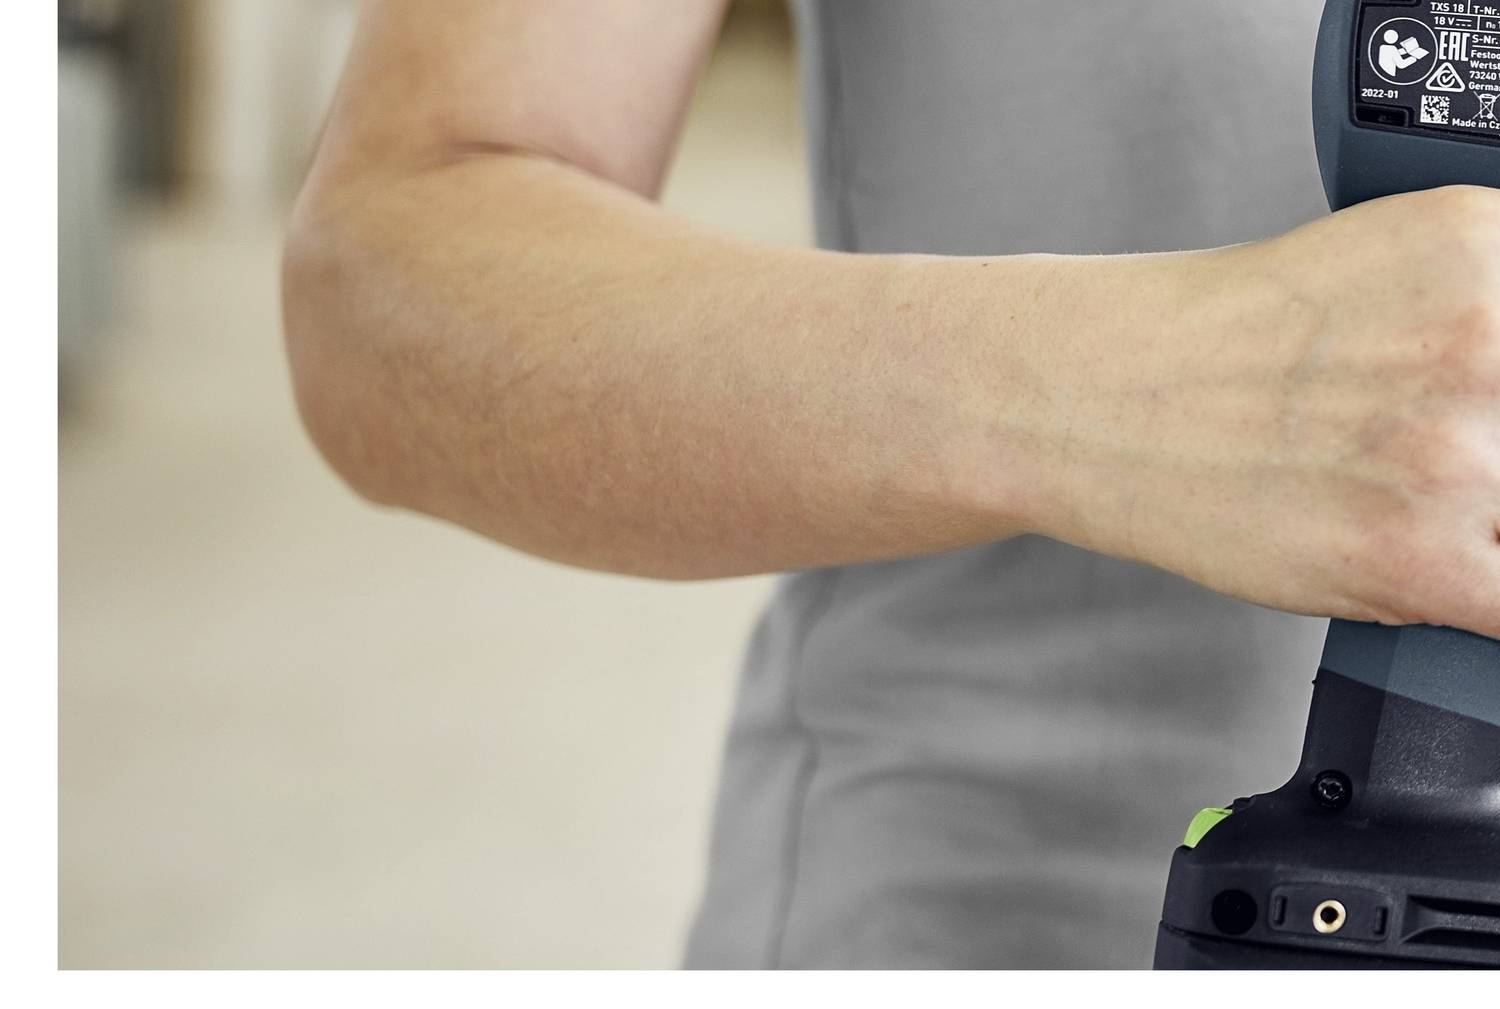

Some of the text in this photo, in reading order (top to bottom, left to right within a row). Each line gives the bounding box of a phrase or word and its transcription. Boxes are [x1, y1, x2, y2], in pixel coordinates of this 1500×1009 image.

[1430, 2, 1464, 13] TXS 18
[1473, 5, 1500, 16] T-Nr.
[1434, 16, 1446, 26] 18
[1472, 34, 1499, 45] S-Nr.
[1438, 31, 1470, 62] EAC
[1469, 71, 1497, 81] 73240
[1361, 88, 1399, 99] 2022-01
[1452, 118, 1476, 128] Made
[1478, 120, 1487, 129] in
